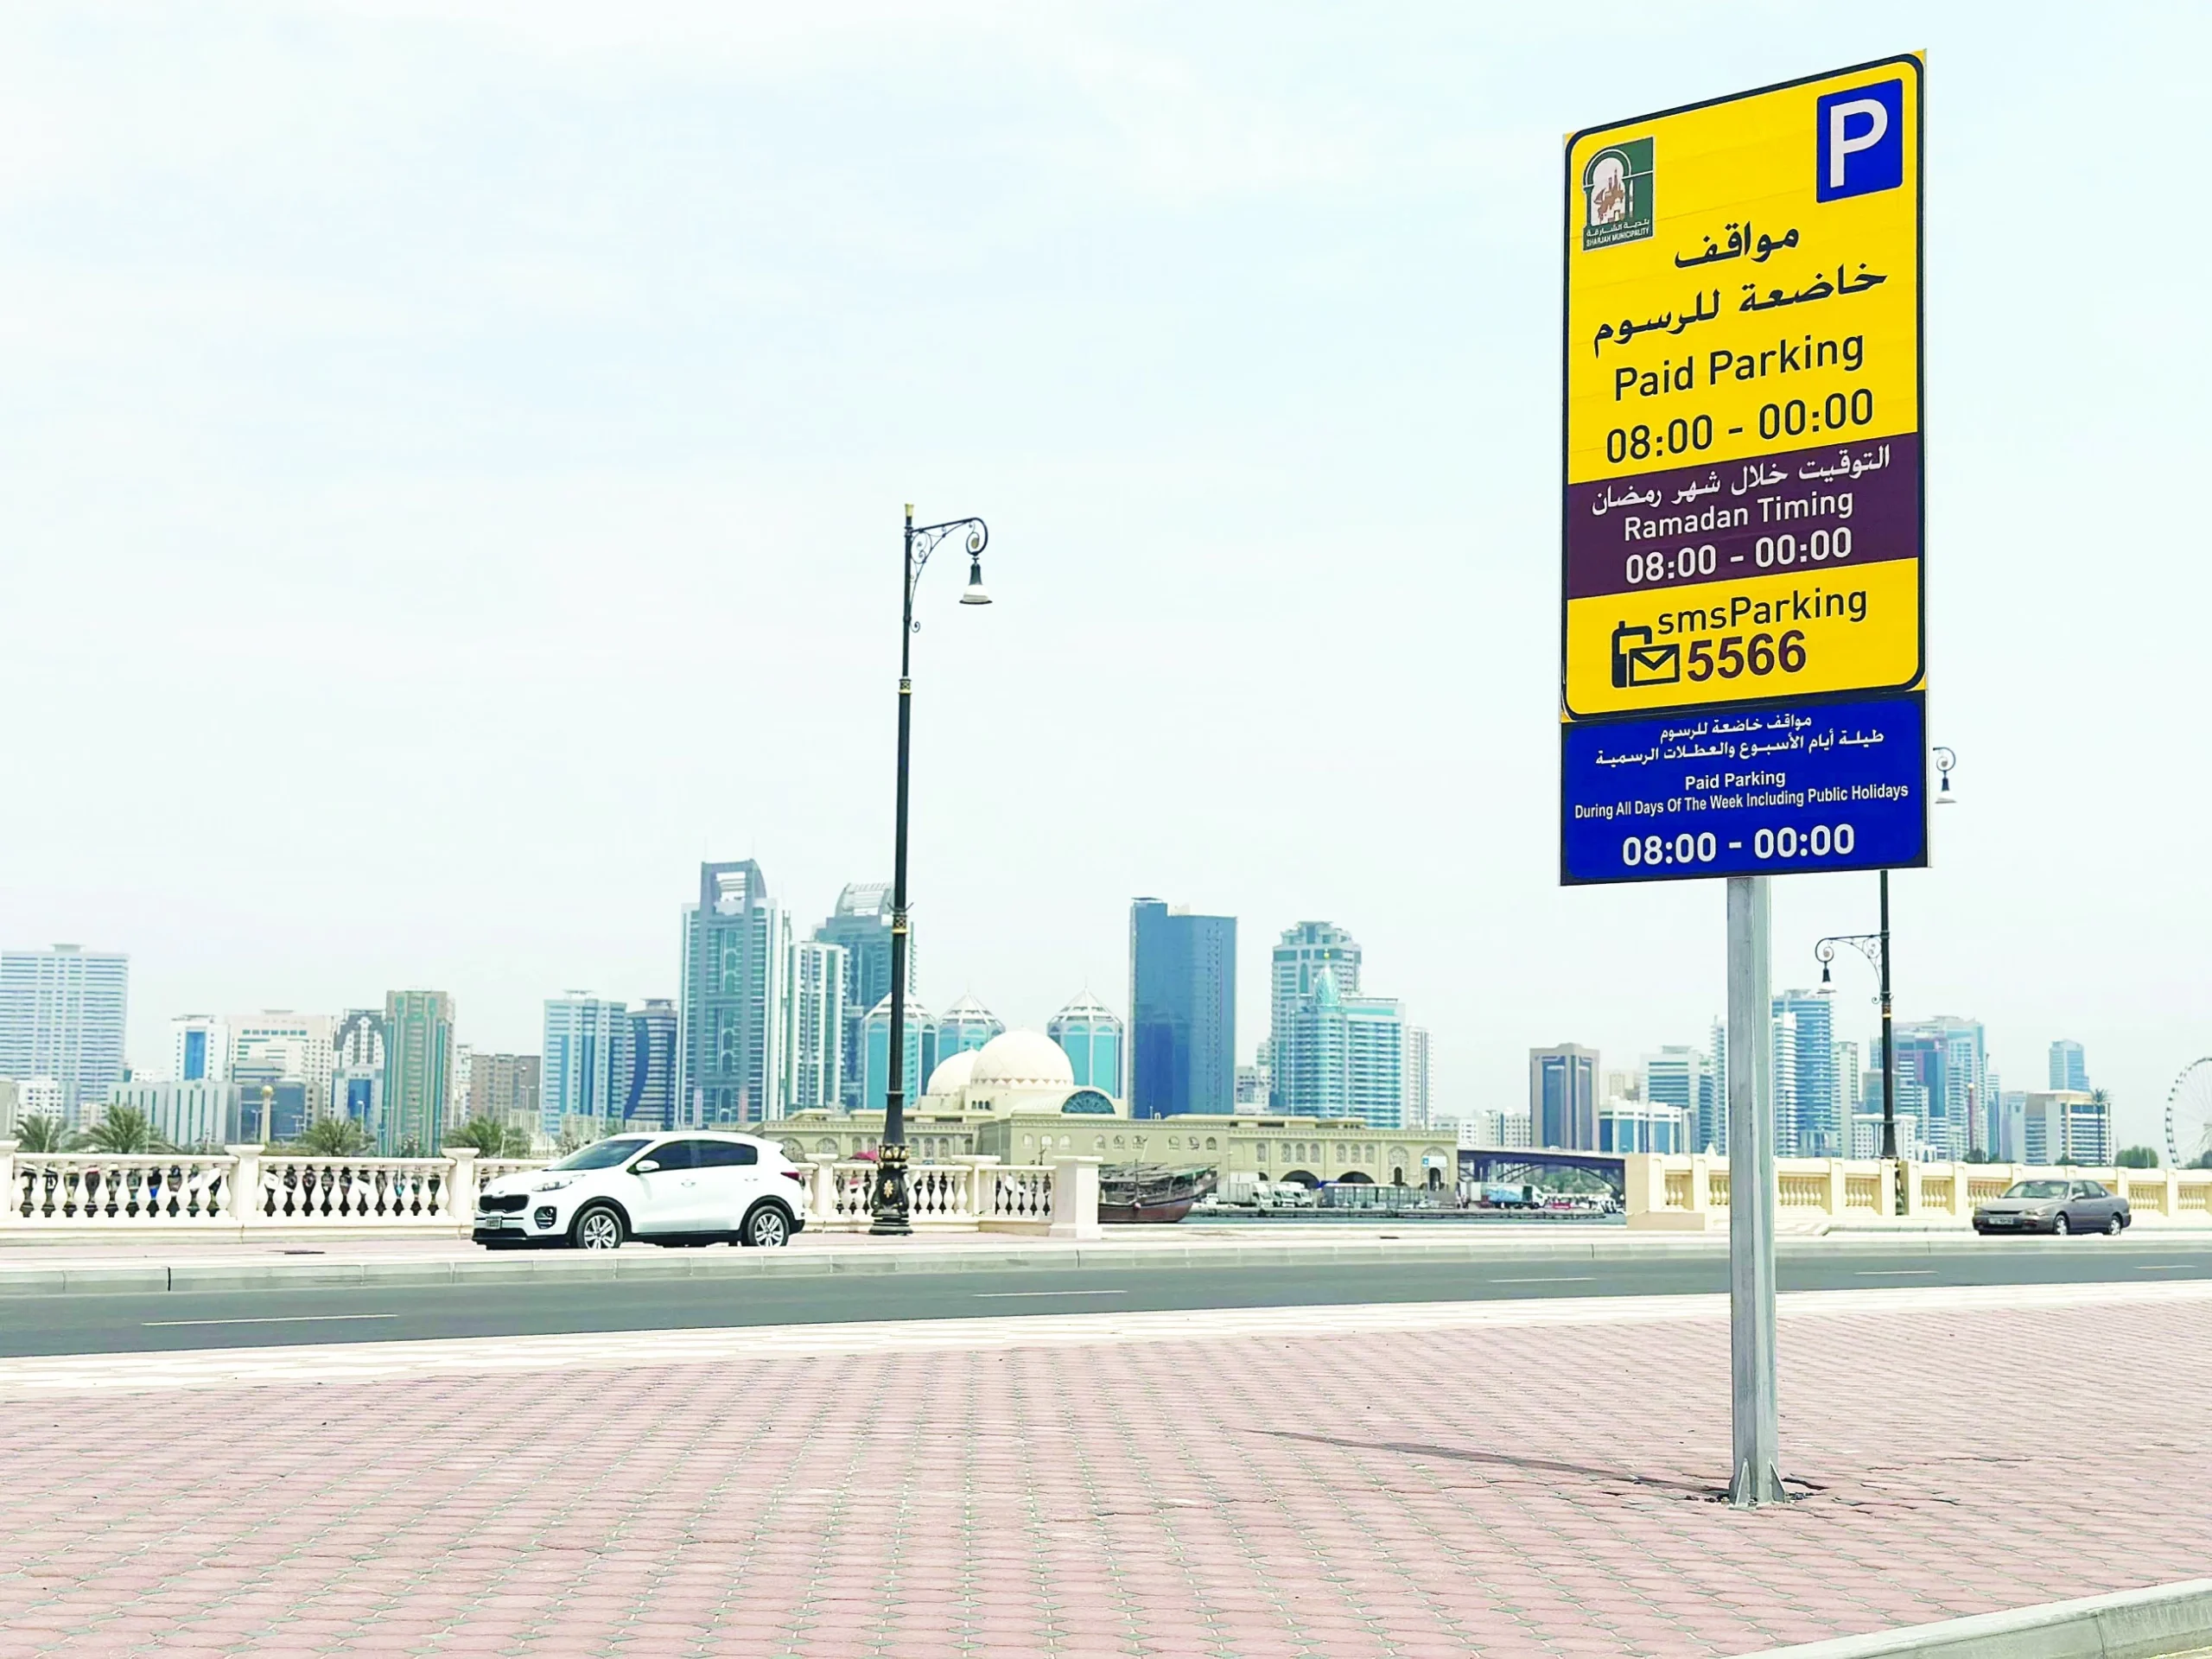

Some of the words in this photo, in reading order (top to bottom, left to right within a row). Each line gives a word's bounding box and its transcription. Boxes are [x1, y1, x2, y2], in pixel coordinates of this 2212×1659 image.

[1830, 99, 1888, 188] P
[1586, 236, 1611, 246] SHARJAH
[1612, 226, 1649, 241] MUNICIPALITY
[1675, 221, 1799, 269] مواقف
[1738, 263, 1888, 312] خاضعة
[1593, 289, 1719, 358] للرسوم
[1615, 356, 1693, 400] Paid
[1710, 334, 1863, 385] Parking
[1607, 415, 1713, 463] 08:00
[1759, 389, 1872, 440] 00:00
[1731, 463, 1789, 495] خلال
[1798, 444, 1890, 482] التوقيت
[1592, 486, 1662, 515] رمضان
[1672, 471, 1720, 504] شهر
[1624, 505, 1748, 541] Ramadan
[1758, 492, 1853, 518] Timing
[1626, 545, 1716, 584] 08:00
[1756, 527, 1852, 568] 00:00
[1658, 589, 1866, 635] smsParking
[1688, 630, 1806, 682] 5566
[1661, 723, 1707, 744] للرسوم
[1712, 718, 1762, 734] خاضعة
[1767, 714, 1811, 730] مواقف
[1839, 729, 1884, 744] طيلة
[1596, 747, 1658, 767] الرسمية
[1663, 741, 1735, 760] والعطلات
[1739, 734, 1803, 760] الأسبوع
[1808, 728, 1834, 753] أيام
[1685, 773, 1719, 790] Paid
[1725, 771, 1785, 788] Parking
[1575, 802, 1613, 819] During
[1616, 799, 1631, 815] All
[1635, 799, 1663, 817] Days
[1667, 797, 1682, 812] Of
[1685, 796, 1707, 811] The
[1710, 794, 1743, 808] Week
[1746, 789, 1804, 807] Including
[1808, 786, 1848, 802] Public
[1852, 784, 1909, 801] Holidays
[1623, 832, 1716, 865] 08:00
[1754, 824, 1854, 859] 00:00
